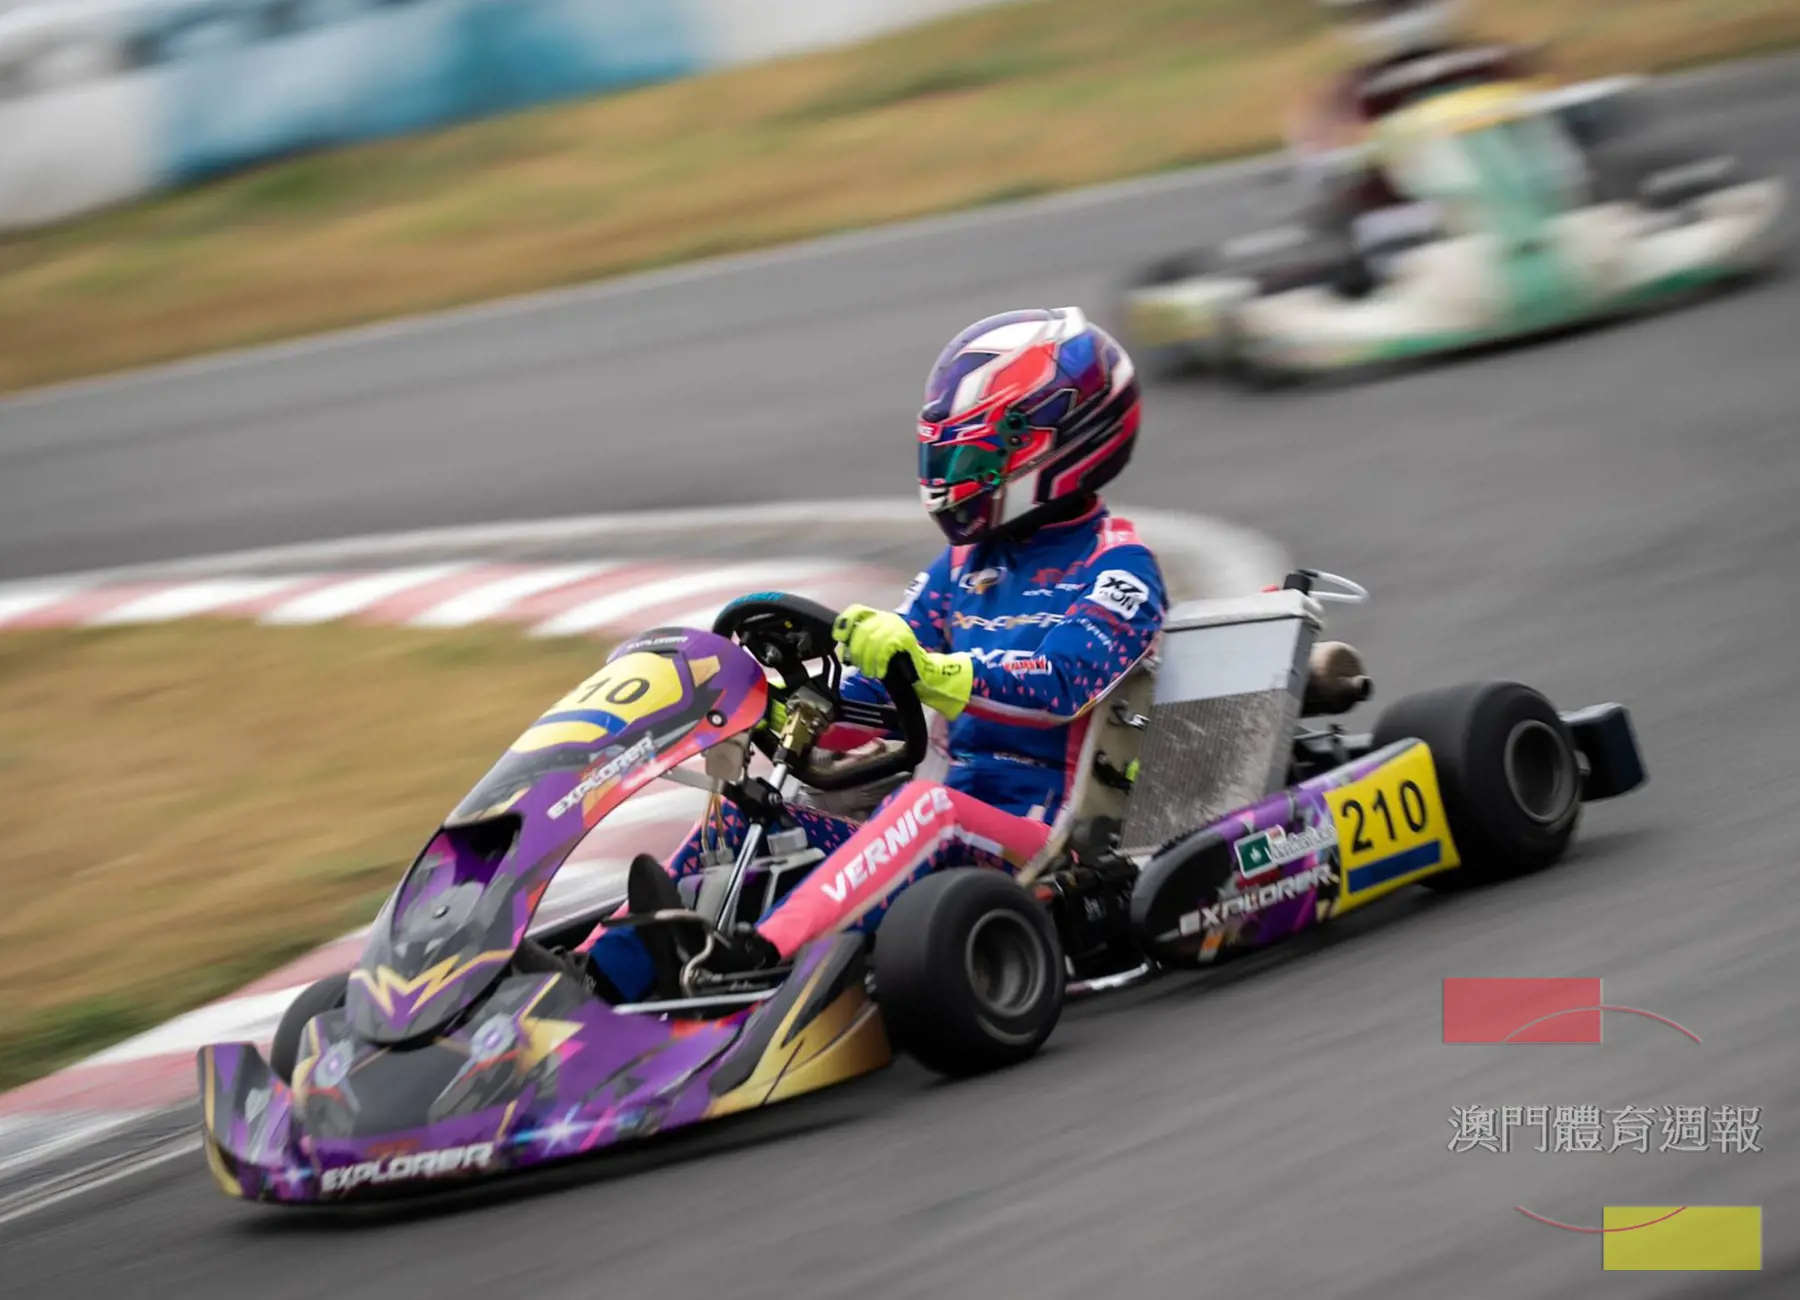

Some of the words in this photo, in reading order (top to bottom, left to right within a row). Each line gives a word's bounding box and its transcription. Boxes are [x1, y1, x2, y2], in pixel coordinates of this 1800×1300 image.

[546, 734, 654, 820] EXPLORER
[820, 785, 954, 903] VERNICE
[1341, 779, 1427, 856] 210
[1179, 862, 1336, 937] EXPLORER
[321, 1141, 495, 1193] EXPLORER
